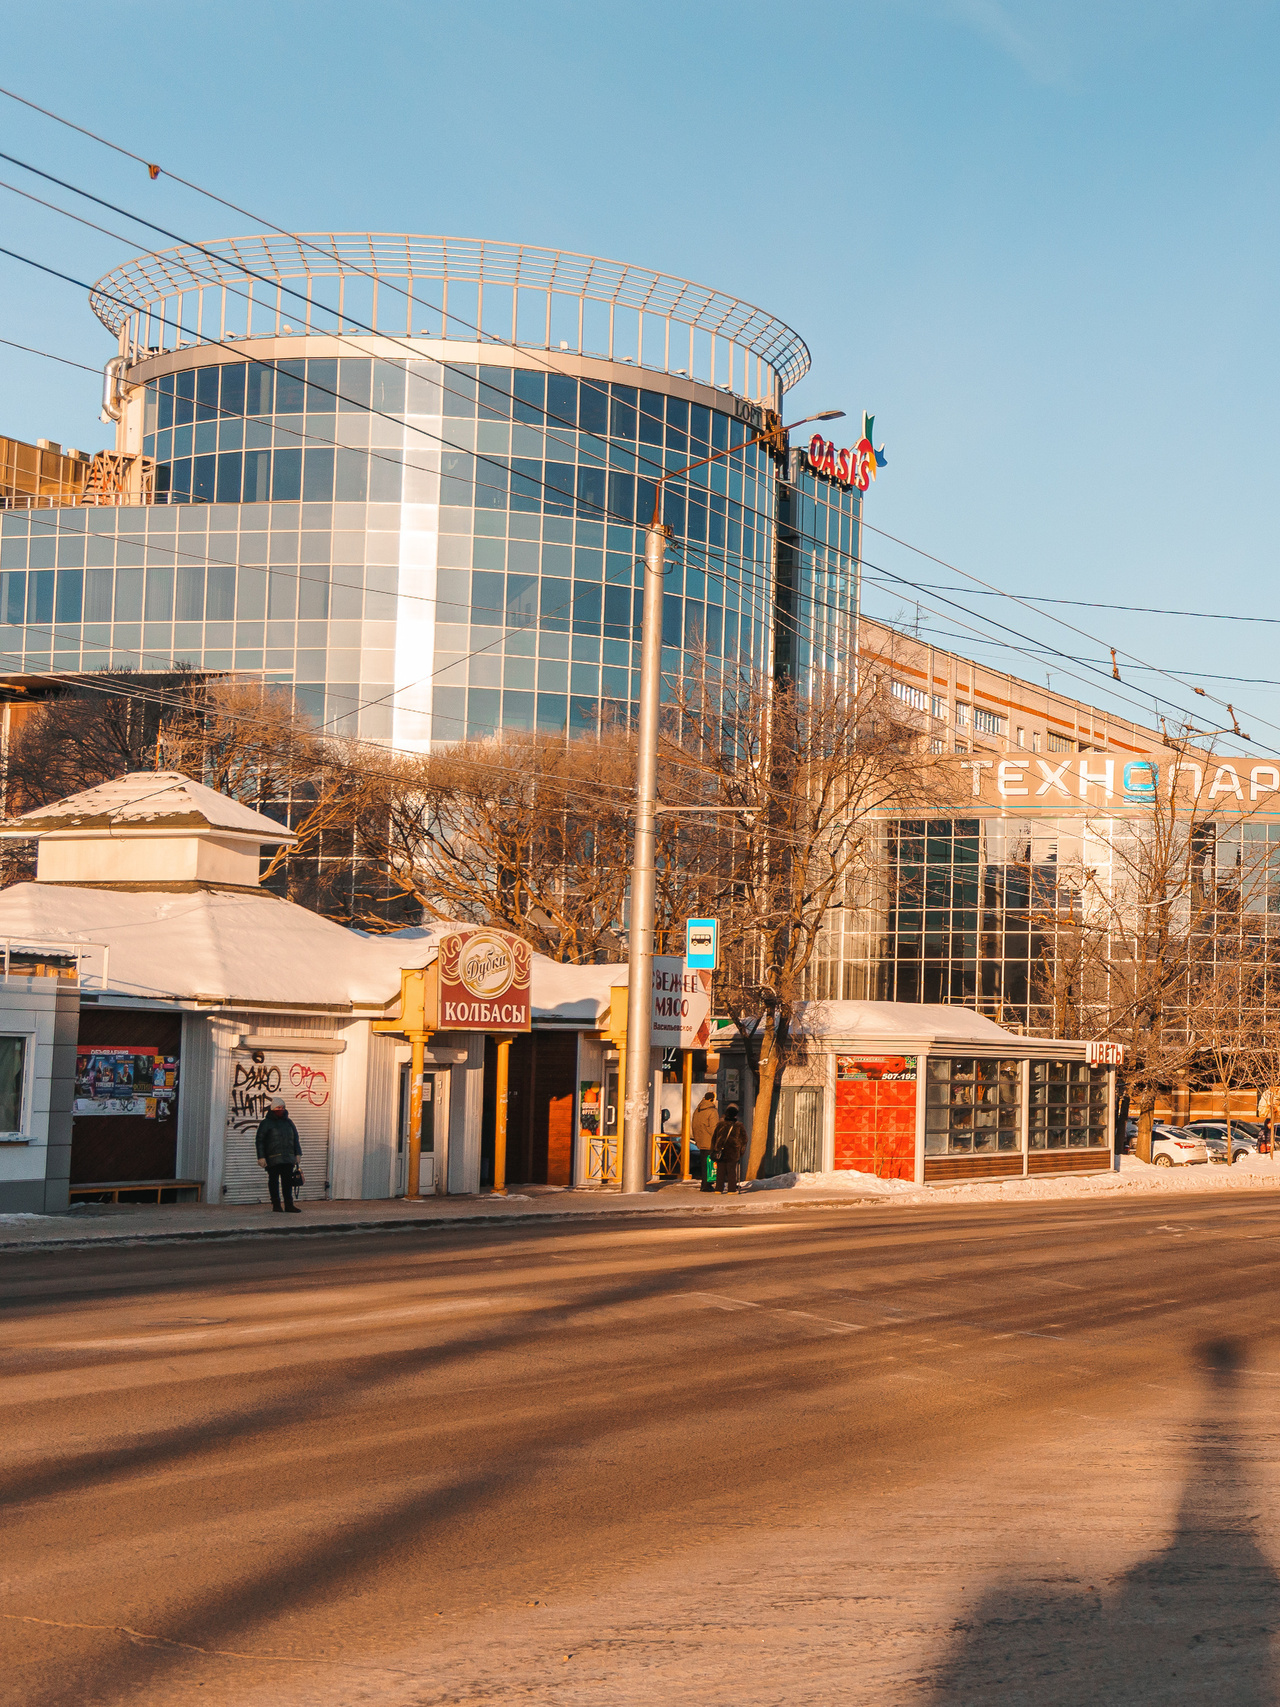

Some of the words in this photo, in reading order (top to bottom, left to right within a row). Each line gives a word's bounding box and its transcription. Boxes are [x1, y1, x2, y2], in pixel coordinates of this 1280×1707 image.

[735, 401, 762, 427] LOFT
[808, 433, 870, 491] OASIS
[467, 951, 507, 982] Дубки
[445, 1002, 526, 1023] КОЛБАСЫ
[655, 997, 689, 1017] МЯСО
[653, 1022, 692, 1032] Васильевское
[881, 1072, 917, 1080] 507-192
